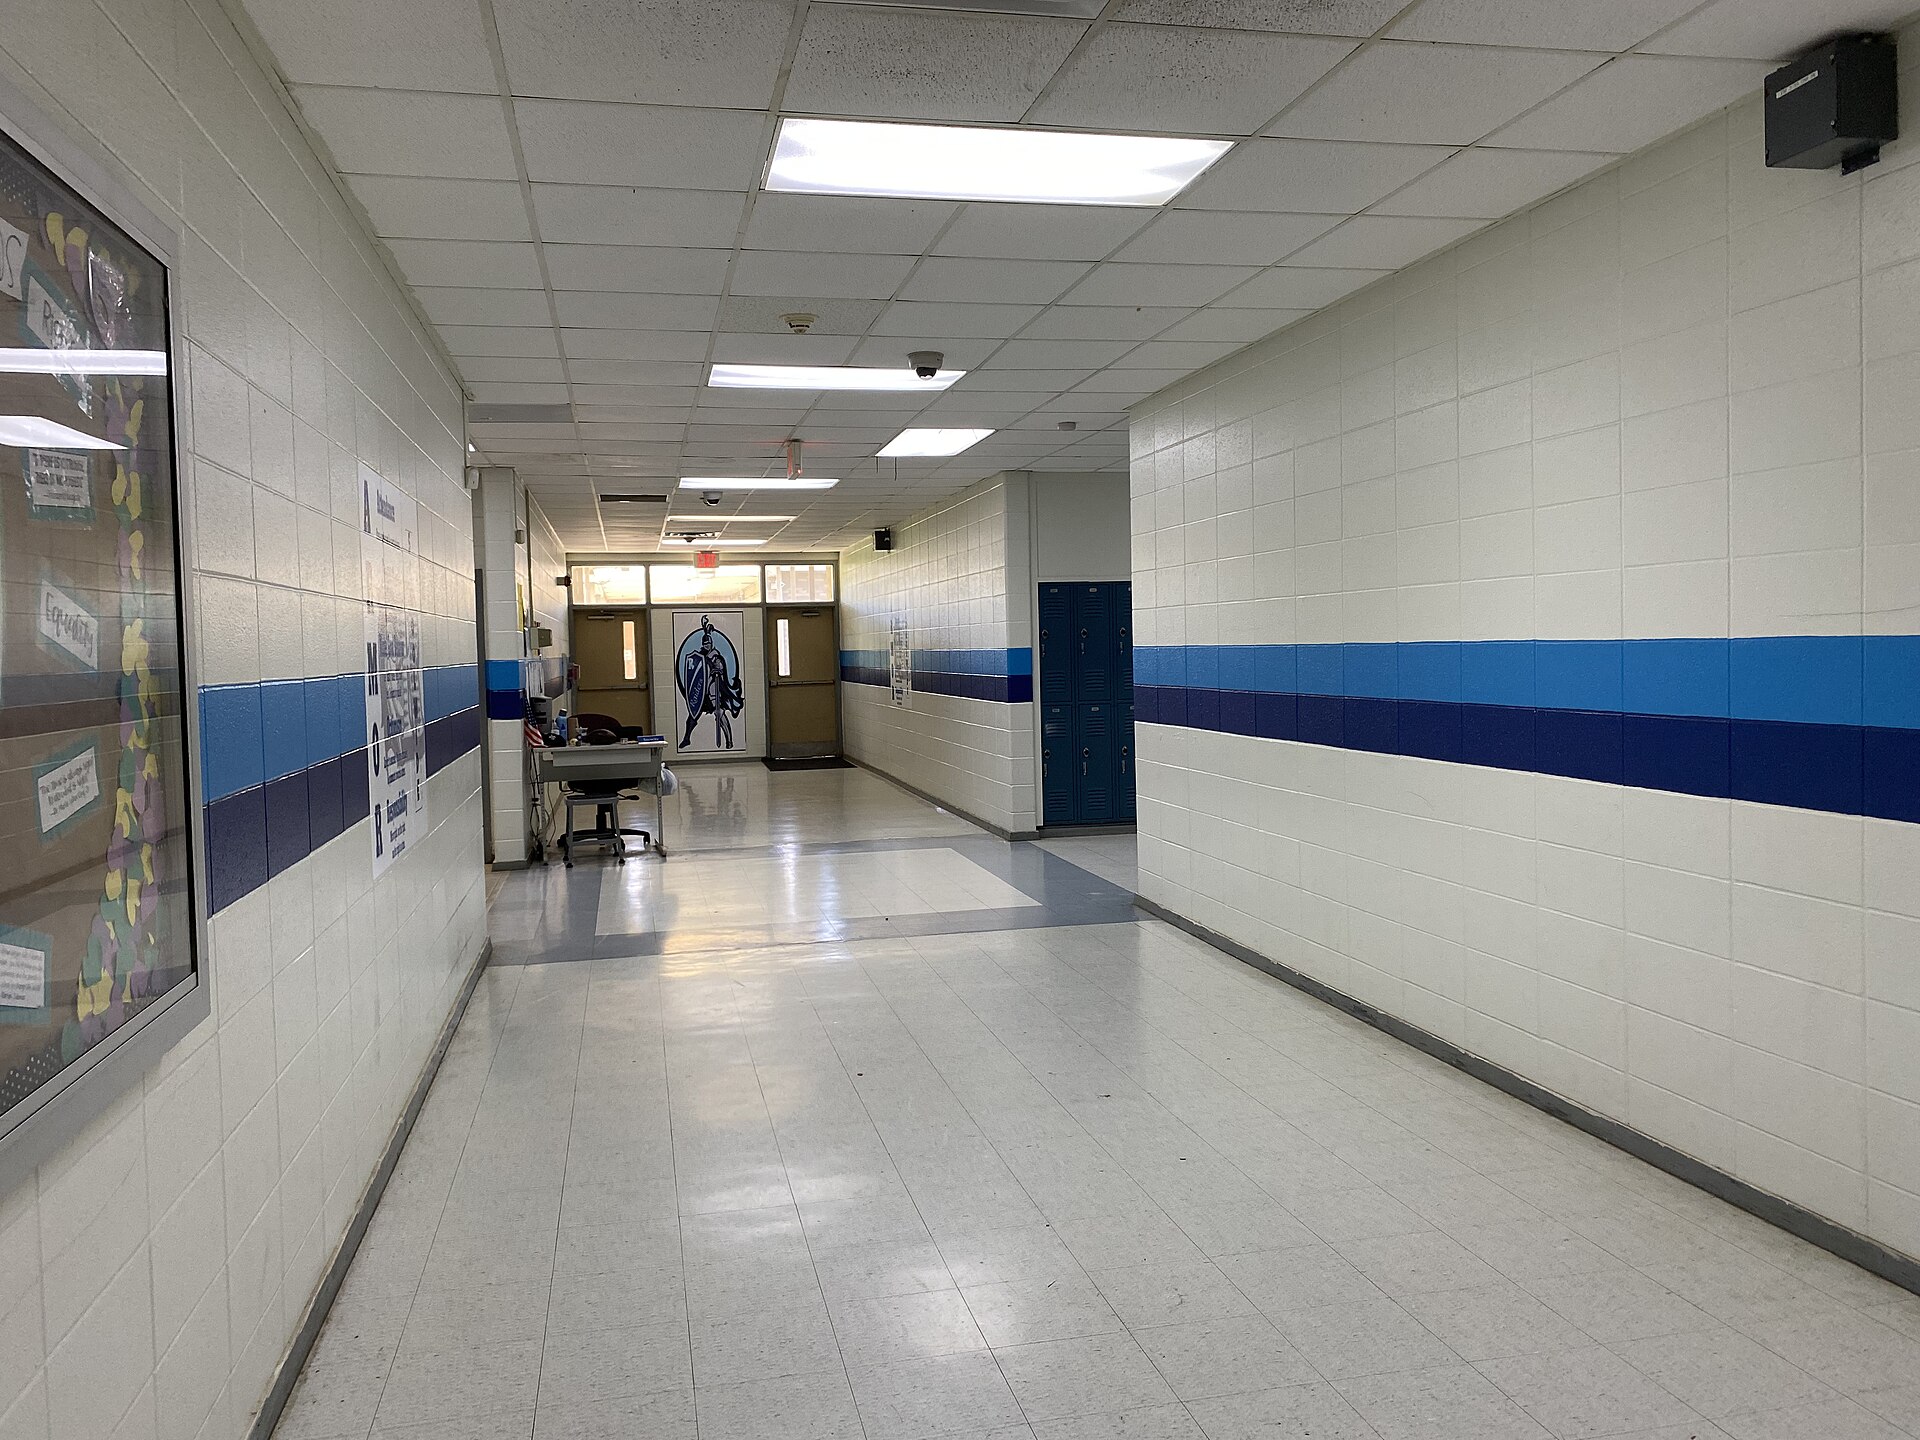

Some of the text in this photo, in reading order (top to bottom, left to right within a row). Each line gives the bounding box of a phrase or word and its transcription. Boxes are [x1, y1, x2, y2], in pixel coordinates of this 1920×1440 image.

[366, 642, 379, 696] M
[688, 657, 695, 670] R
[690, 678, 703, 708] Raiders
[372, 721, 380, 778] O
[374, 803, 384, 858] R
